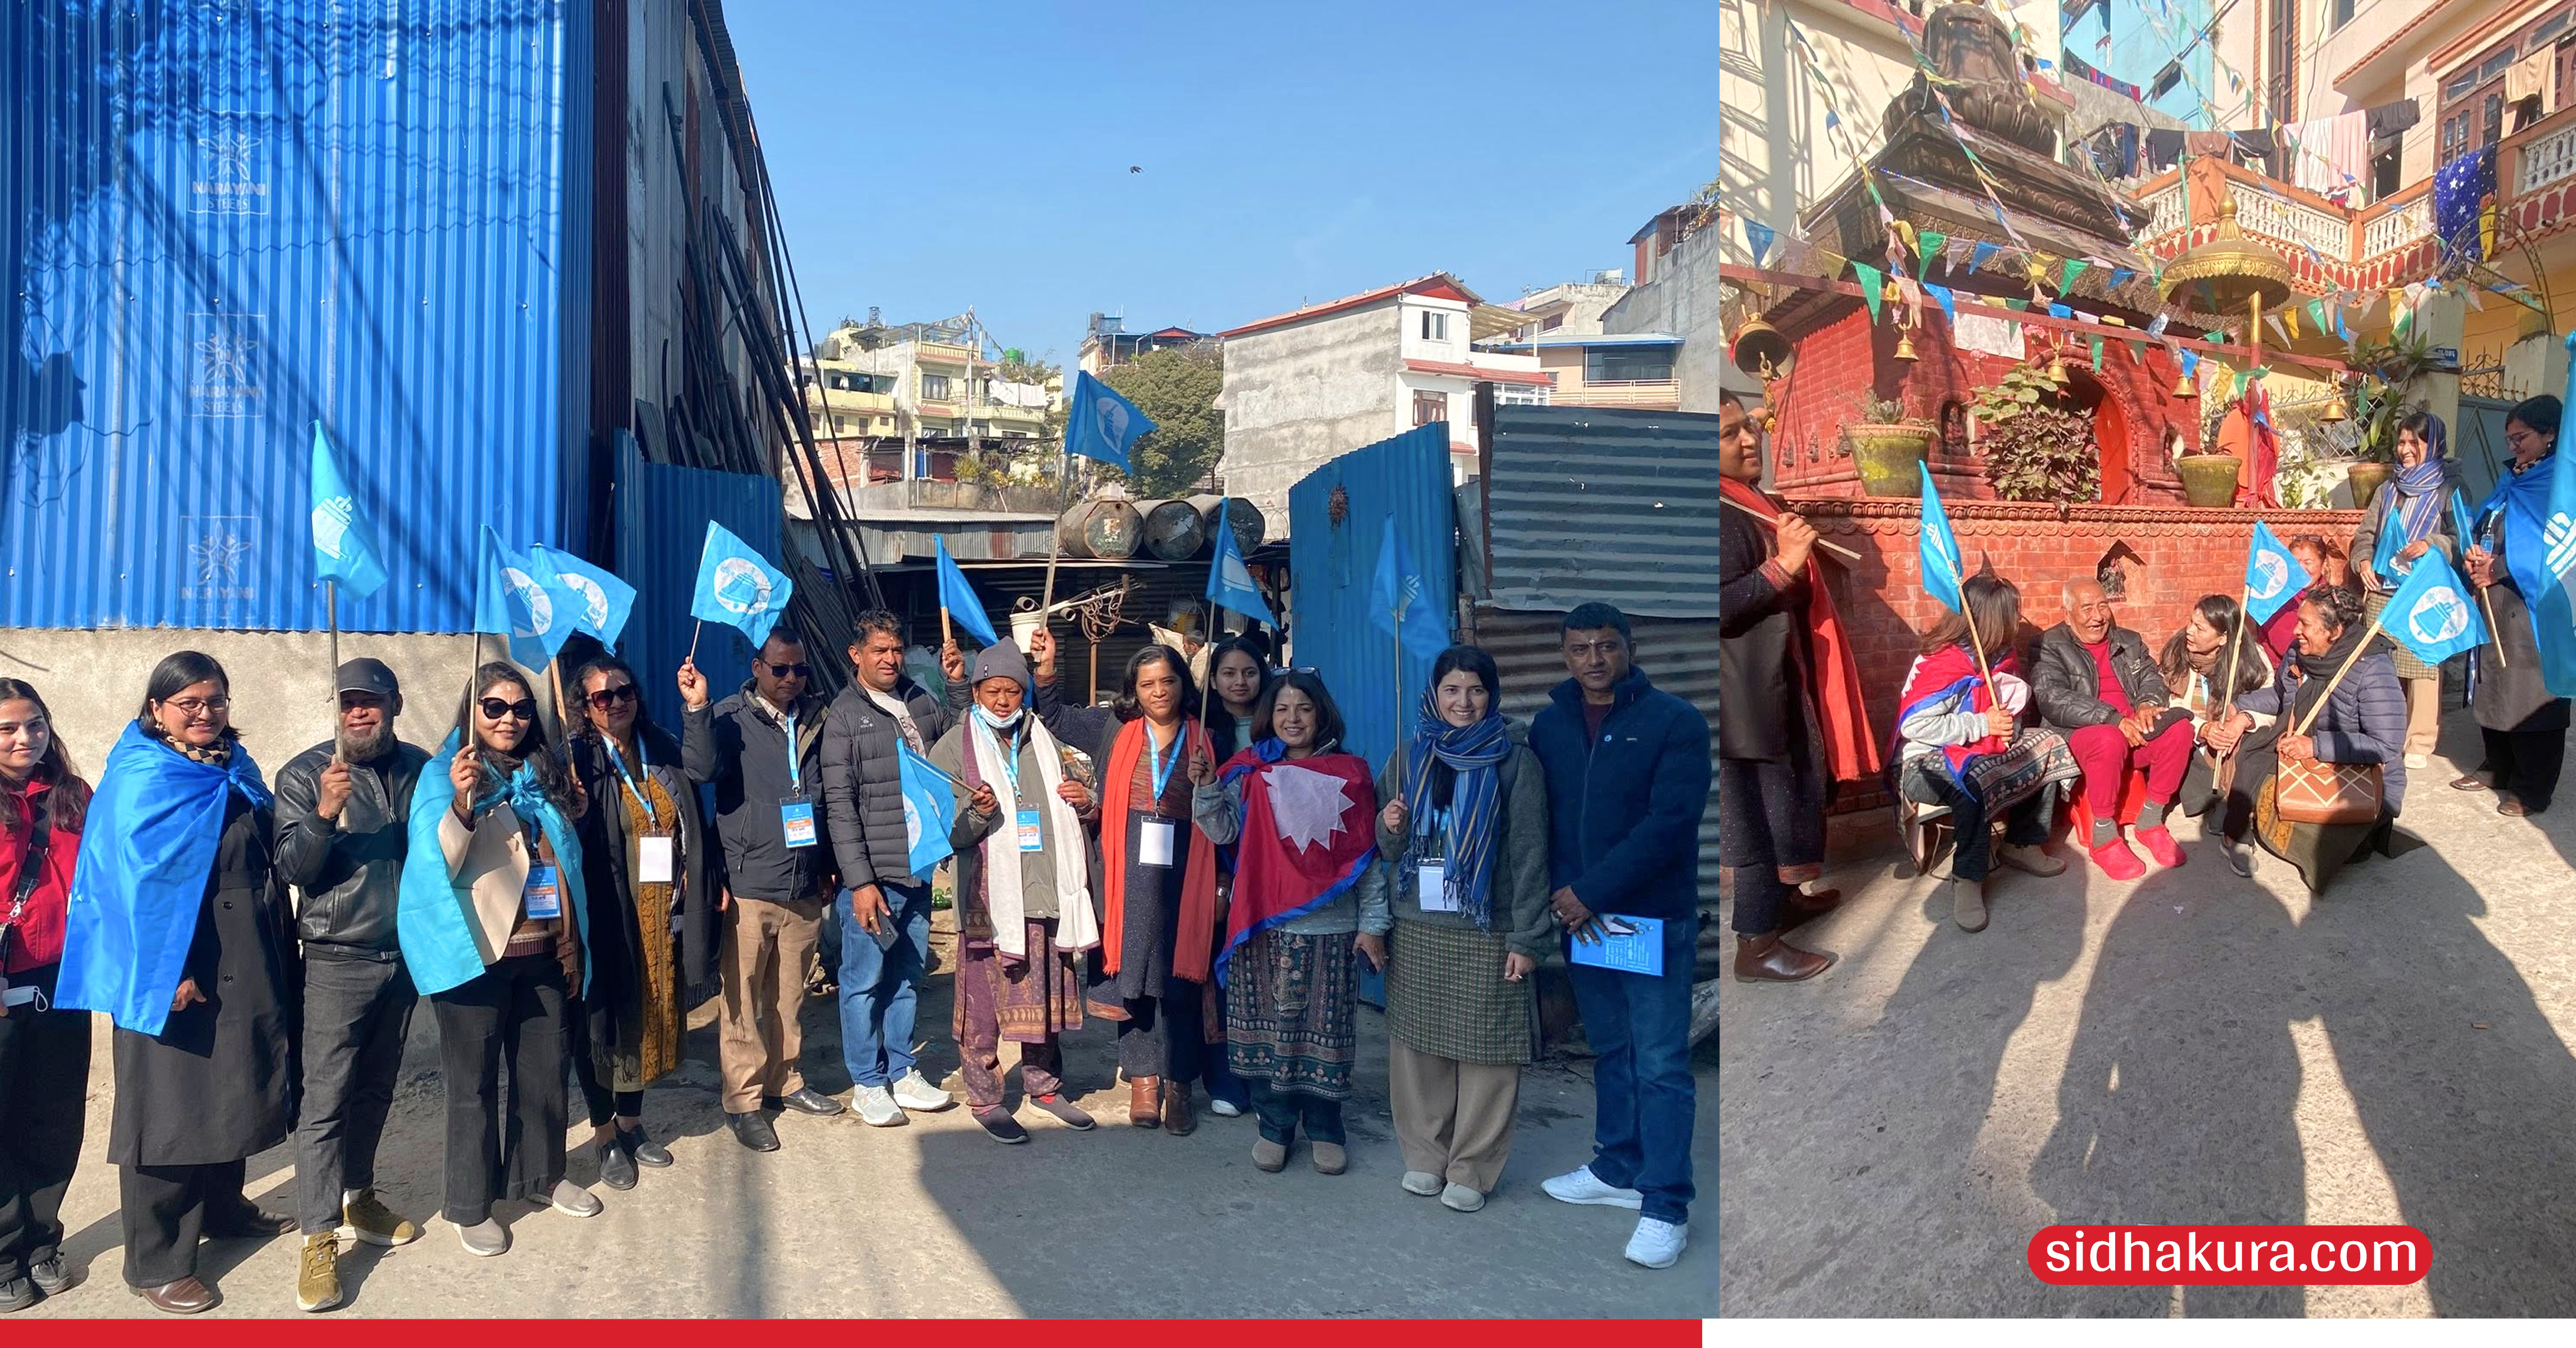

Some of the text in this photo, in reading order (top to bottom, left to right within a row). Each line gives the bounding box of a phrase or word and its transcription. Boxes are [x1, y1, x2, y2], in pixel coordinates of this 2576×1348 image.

[192, 180, 266, 196] NARAYANI
[208, 198, 248, 210] STEELS
[189, 384, 262, 399] NARAYANI
[203, 401, 243, 413] STEELS
